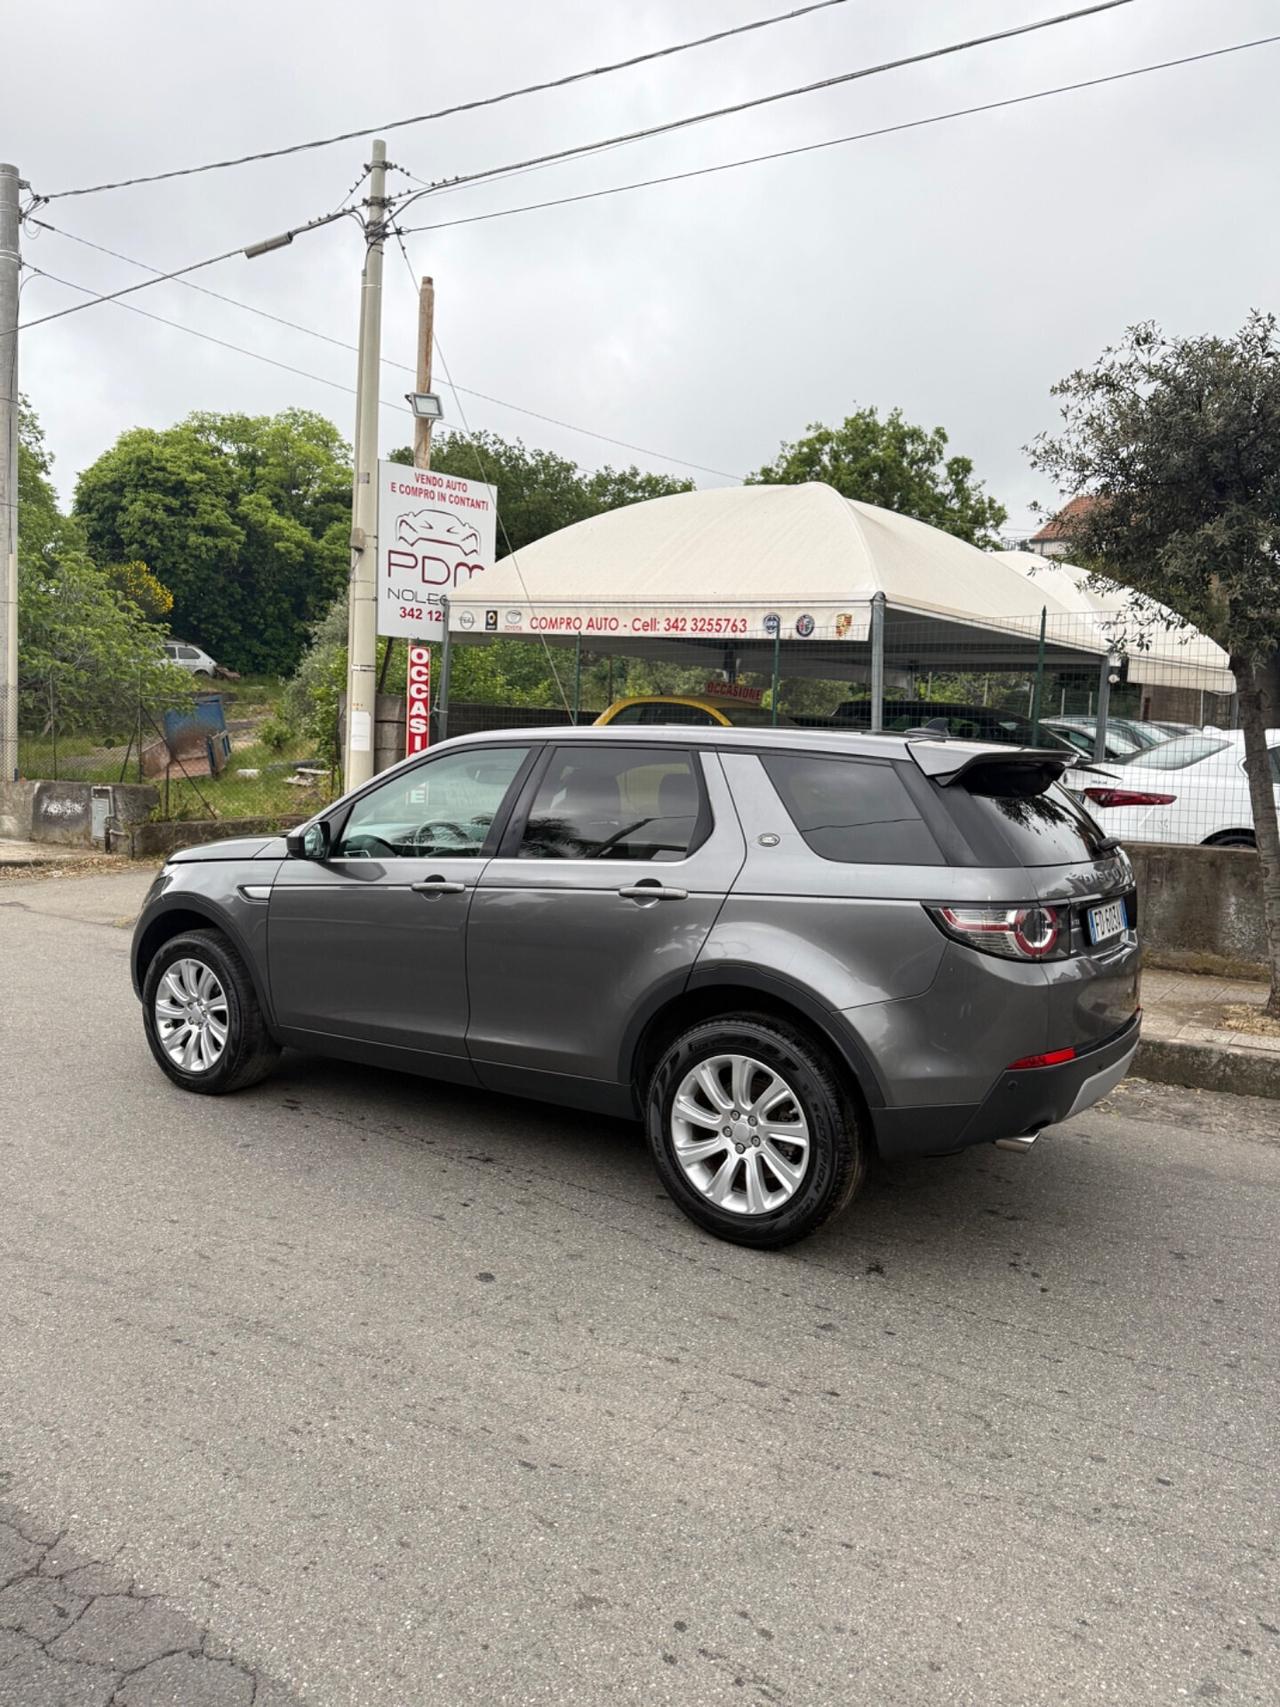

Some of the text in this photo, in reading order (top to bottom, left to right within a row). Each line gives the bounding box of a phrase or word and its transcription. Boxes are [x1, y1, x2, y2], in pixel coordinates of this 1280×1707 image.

[415, 472, 468, 493] VENDO AUTO
[391, 482, 489, 511] E COMPRO IN CONTANTI
[399, 606, 423, 620] 342
[529, 616, 583, 630] COMPRO
[586, 617, 619, 631] AUTO
[631, 617, 661, 632] Cell:
[663, 617, 688, 632] 342
[690, 617, 748, 633] 3255763
[707, 681, 762, 700] OCCASIONE
